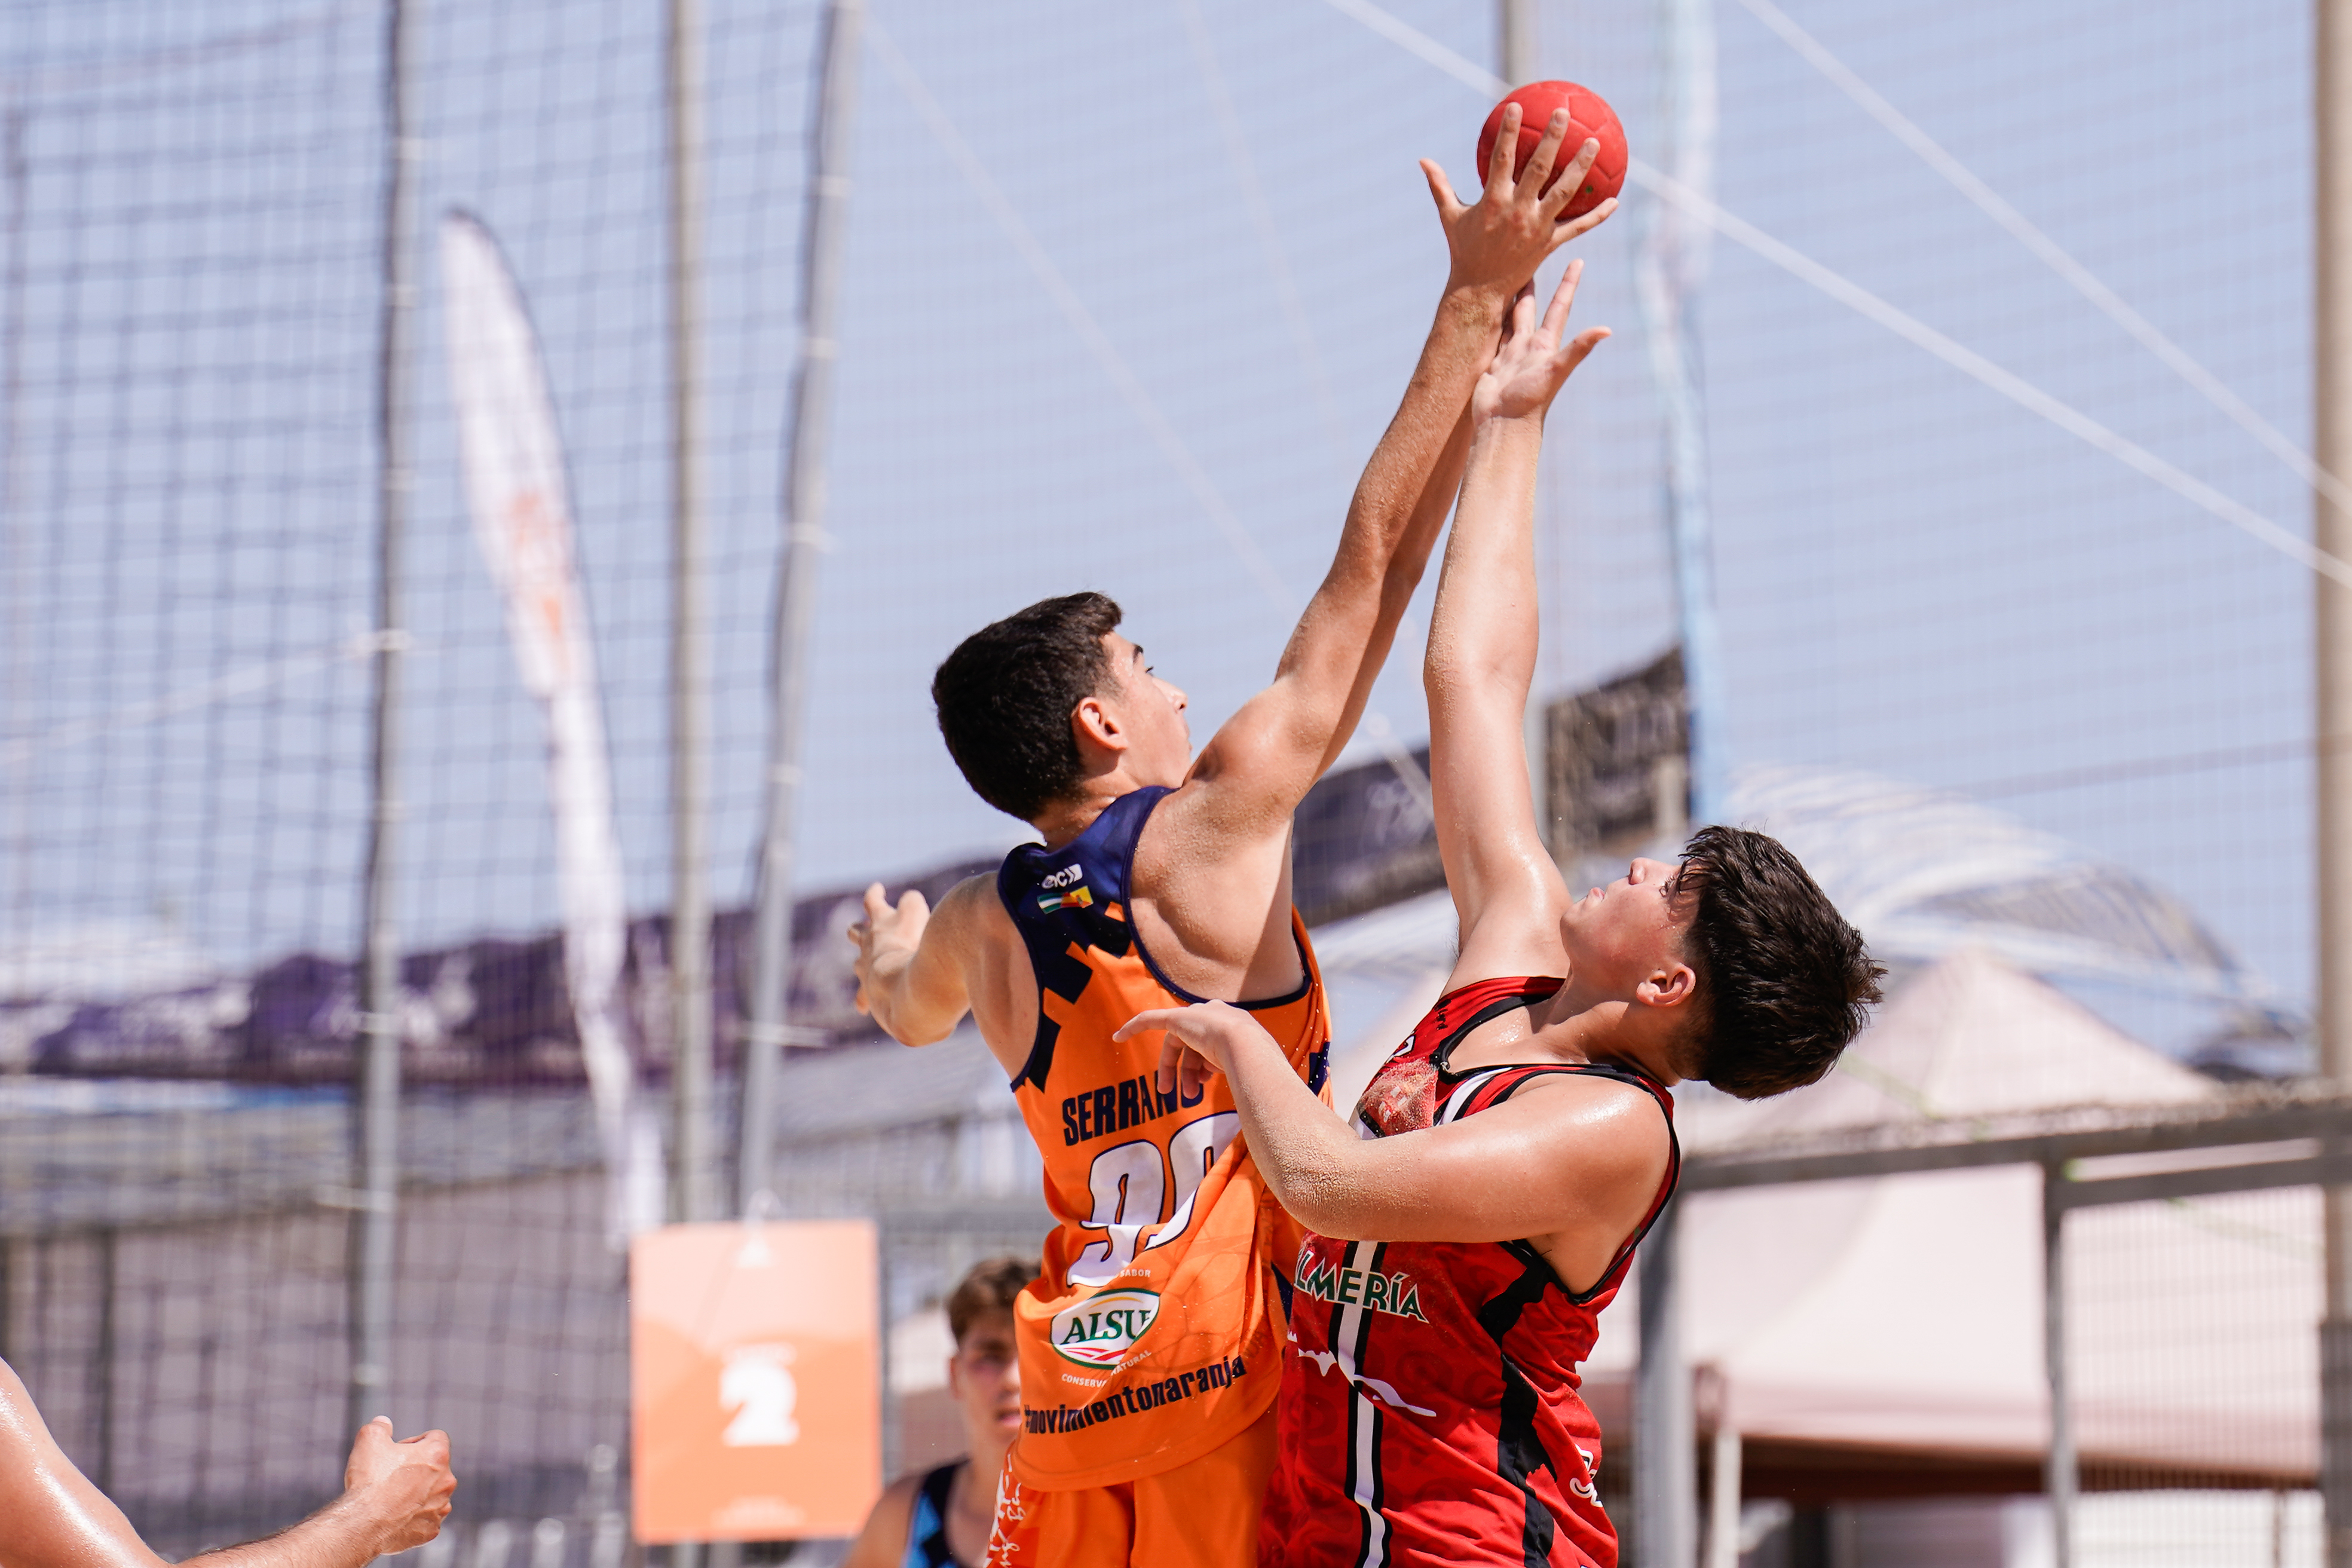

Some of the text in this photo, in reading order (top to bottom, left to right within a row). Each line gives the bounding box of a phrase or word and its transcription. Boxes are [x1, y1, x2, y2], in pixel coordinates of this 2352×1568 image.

[1294, 1247, 1430, 1324] LMERÍA
[1060, 1310, 1152, 1345] ALSU
[720, 1354, 800, 1446] 2
